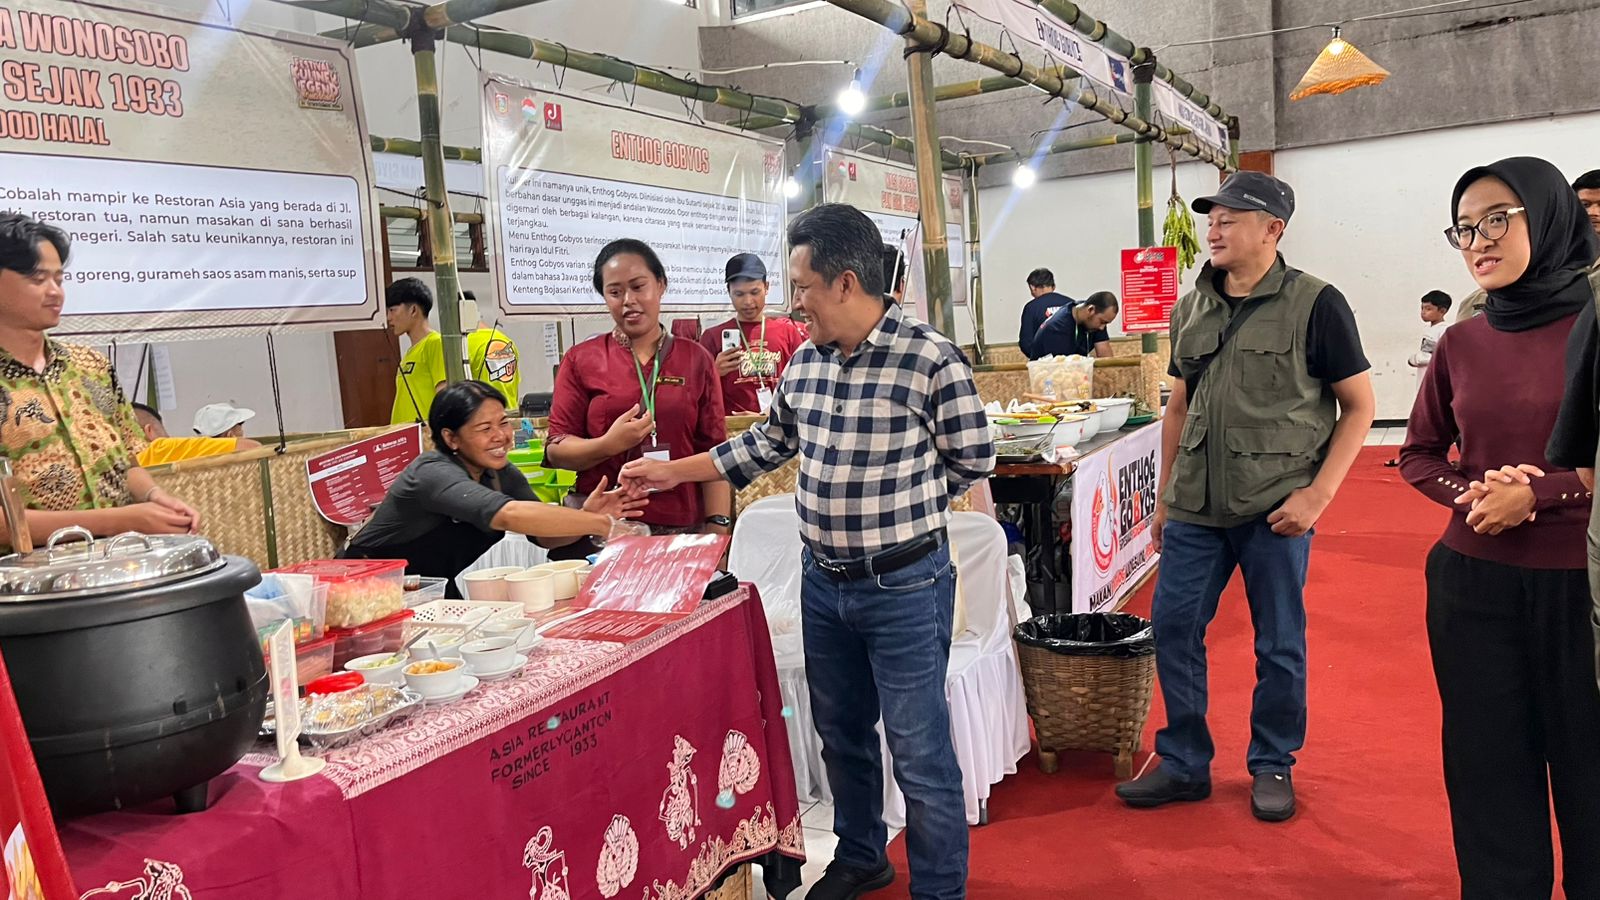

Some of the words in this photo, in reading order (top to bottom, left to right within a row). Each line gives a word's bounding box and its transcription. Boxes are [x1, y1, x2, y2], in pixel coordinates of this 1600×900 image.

[19, 10, 190, 72] WONOSOBO
[2, 60, 104, 110] SEJAK
[109, 73, 184, 117] 1933
[41, 112, 111, 146] HALAL
[611, 130, 662, 165] ENTHOG
[662, 139, 710, 174] GOBYOS
[542, 180, 574, 194] namanya
[592, 186, 615, 198] Enthog
[0, 186, 61, 201] Cobalah
[68, 191, 127, 206] mampir
[133, 192, 150, 206] ke
[155, 193, 215, 208] Restoran
[219, 196, 246, 210] Asia
[249, 199, 279, 213] yang
[283, 199, 323, 213] berada
[326, 201, 337, 213] di
[339, 201, 352, 214] Jl.
[505, 189, 541, 201] berbahan
[541, 193, 561, 203] dasar
[562, 197, 587, 207] unggas
[597, 200, 622, 210] menjadi
[622, 203, 647, 212] andalan
[32, 210, 96, 223] restoran
[104, 211, 133, 225] tua,
[139, 214, 190, 226] namun
[196, 213, 254, 227] masakan
[260, 215, 272, 228] di
[277, 218, 304, 229] sana
[309, 217, 353, 230] berhasil
[505, 203, 540, 214] digemari
[541, 206, 558, 216] oleh
[559, 208, 589, 219] berbagai
[622, 214, 643, 223] karena
[507, 217, 549, 229] terjangkau.
[70, 229, 122, 244] negeri.
[127, 229, 167, 243] Salah
[171, 231, 201, 244] satu
[205, 230, 288, 247] keunikannya,
[291, 234, 338, 246] restoran
[340, 234, 354, 247] ini
[508, 230, 530, 241] Menu
[531, 233, 557, 244] Enthog
[558, 234, 583, 245] Gobyos
[509, 244, 525, 254] hari
[524, 246, 540, 256] raya
[540, 245, 554, 256] Idul
[554, 247, 570, 256] Fitri.
[510, 257, 537, 269] Enthog
[538, 259, 565, 270] Gobyos
[565, 260, 586, 270] varian
[76, 271, 135, 284] goreng,
[137, 267, 200, 284] gurameh
[202, 269, 232, 281] saos
[233, 268, 267, 280] asam
[268, 267, 307, 281] manis,
[308, 268, 336, 280] serta
[337, 268, 357, 281] sup
[511, 271, 535, 281] dalam
[535, 271, 561, 282] bahasa
[561, 272, 579, 282] Jawa
[512, 284, 544, 296] Kenteng
[544, 284, 572, 296] Bojasari
[571, 285, 594, 295] Kertek
[1118, 449, 1156, 501] ENTHOG
[1119, 479, 1156, 537] GOBYOS
[1088, 582, 1112, 612] MAKAN
[489, 735, 524, 762] ASIA
[511, 757, 552, 790] SINCE
[569, 733, 598, 758] 1933
